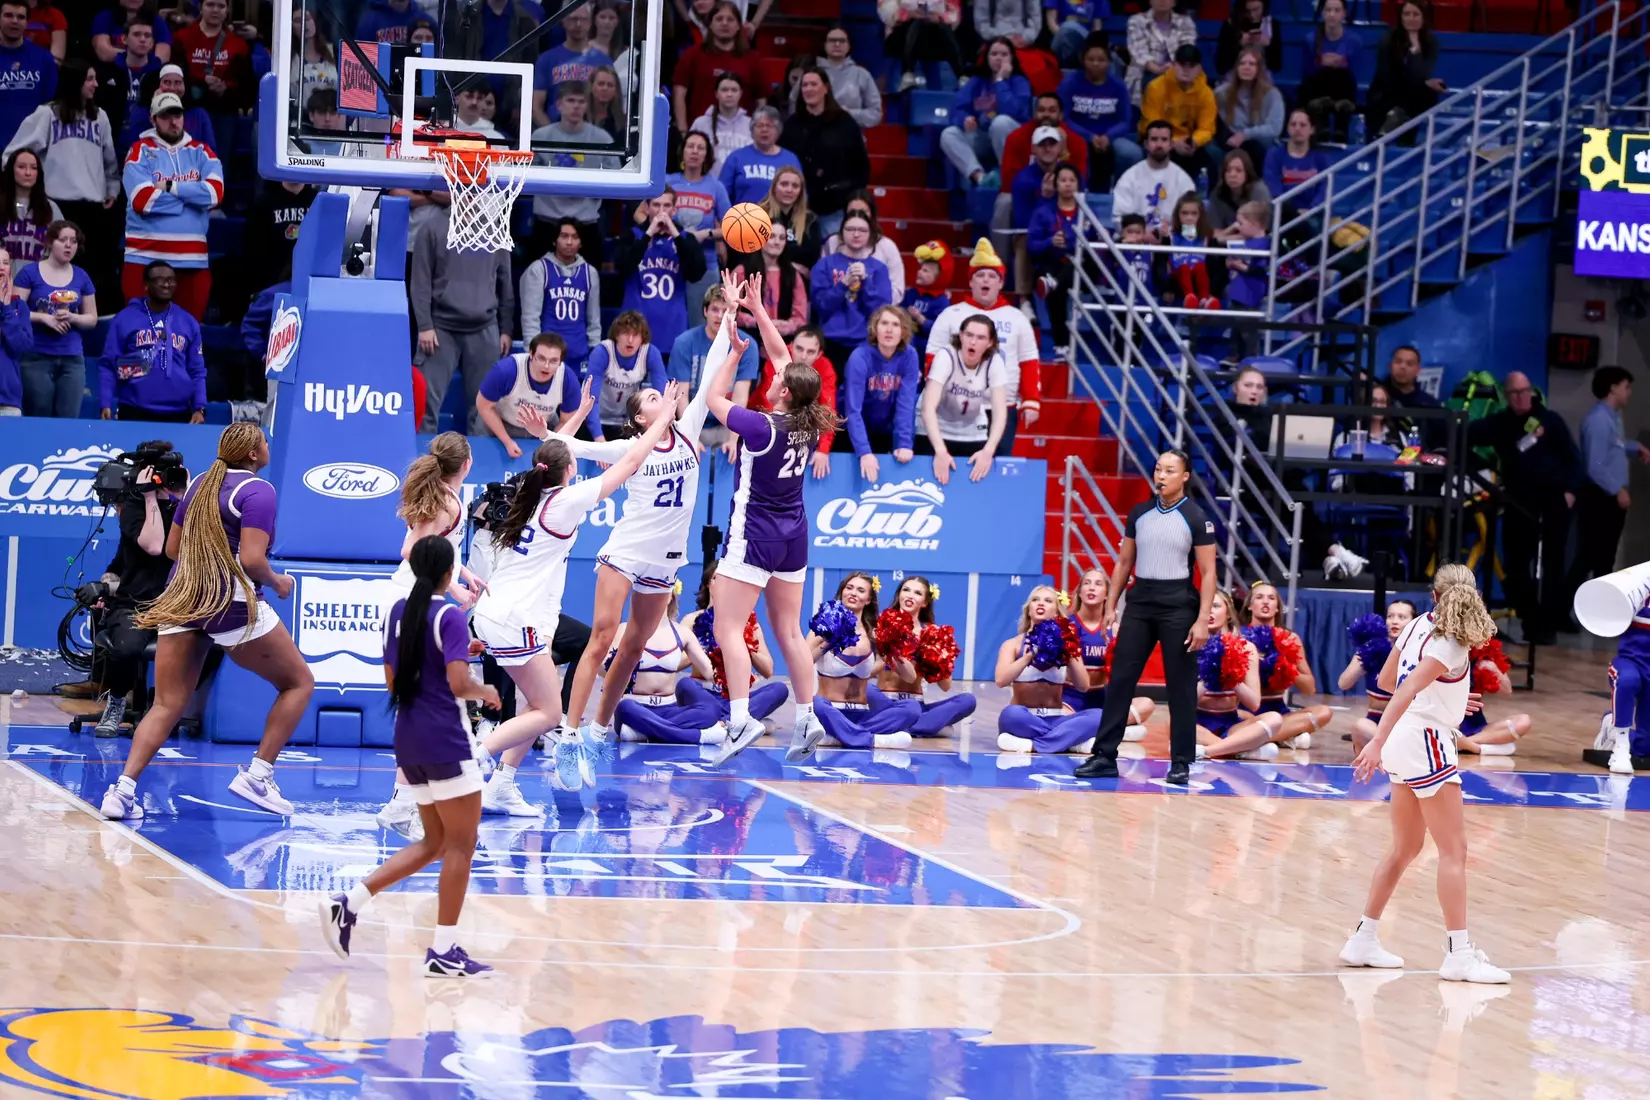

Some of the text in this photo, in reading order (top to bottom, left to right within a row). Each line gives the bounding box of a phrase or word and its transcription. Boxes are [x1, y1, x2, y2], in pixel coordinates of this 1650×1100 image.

[288, 157, 325, 167] SPALDING
[549, 286, 586, 302] KANSAS
[641, 273, 675, 301] 30
[555, 298, 579, 321] 00
[1559, 336, 1590, 363] EXIT
[615, 391, 623, 403] 1
[960, 400, 969, 415] 1
[643, 456, 696, 476] JAYHAWKS
[777, 446, 810, 479] 23
[0, 463, 100, 502] Clu
[322, 467, 380, 492] Ford
[653, 475, 685, 508] 21
[816, 500, 943, 538] Club
[91, 539, 99, 550] 7
[813, 535, 940, 550] CARWASH
[892, 570, 904, 581] 13
[303, 619, 381, 631] INSURANC
